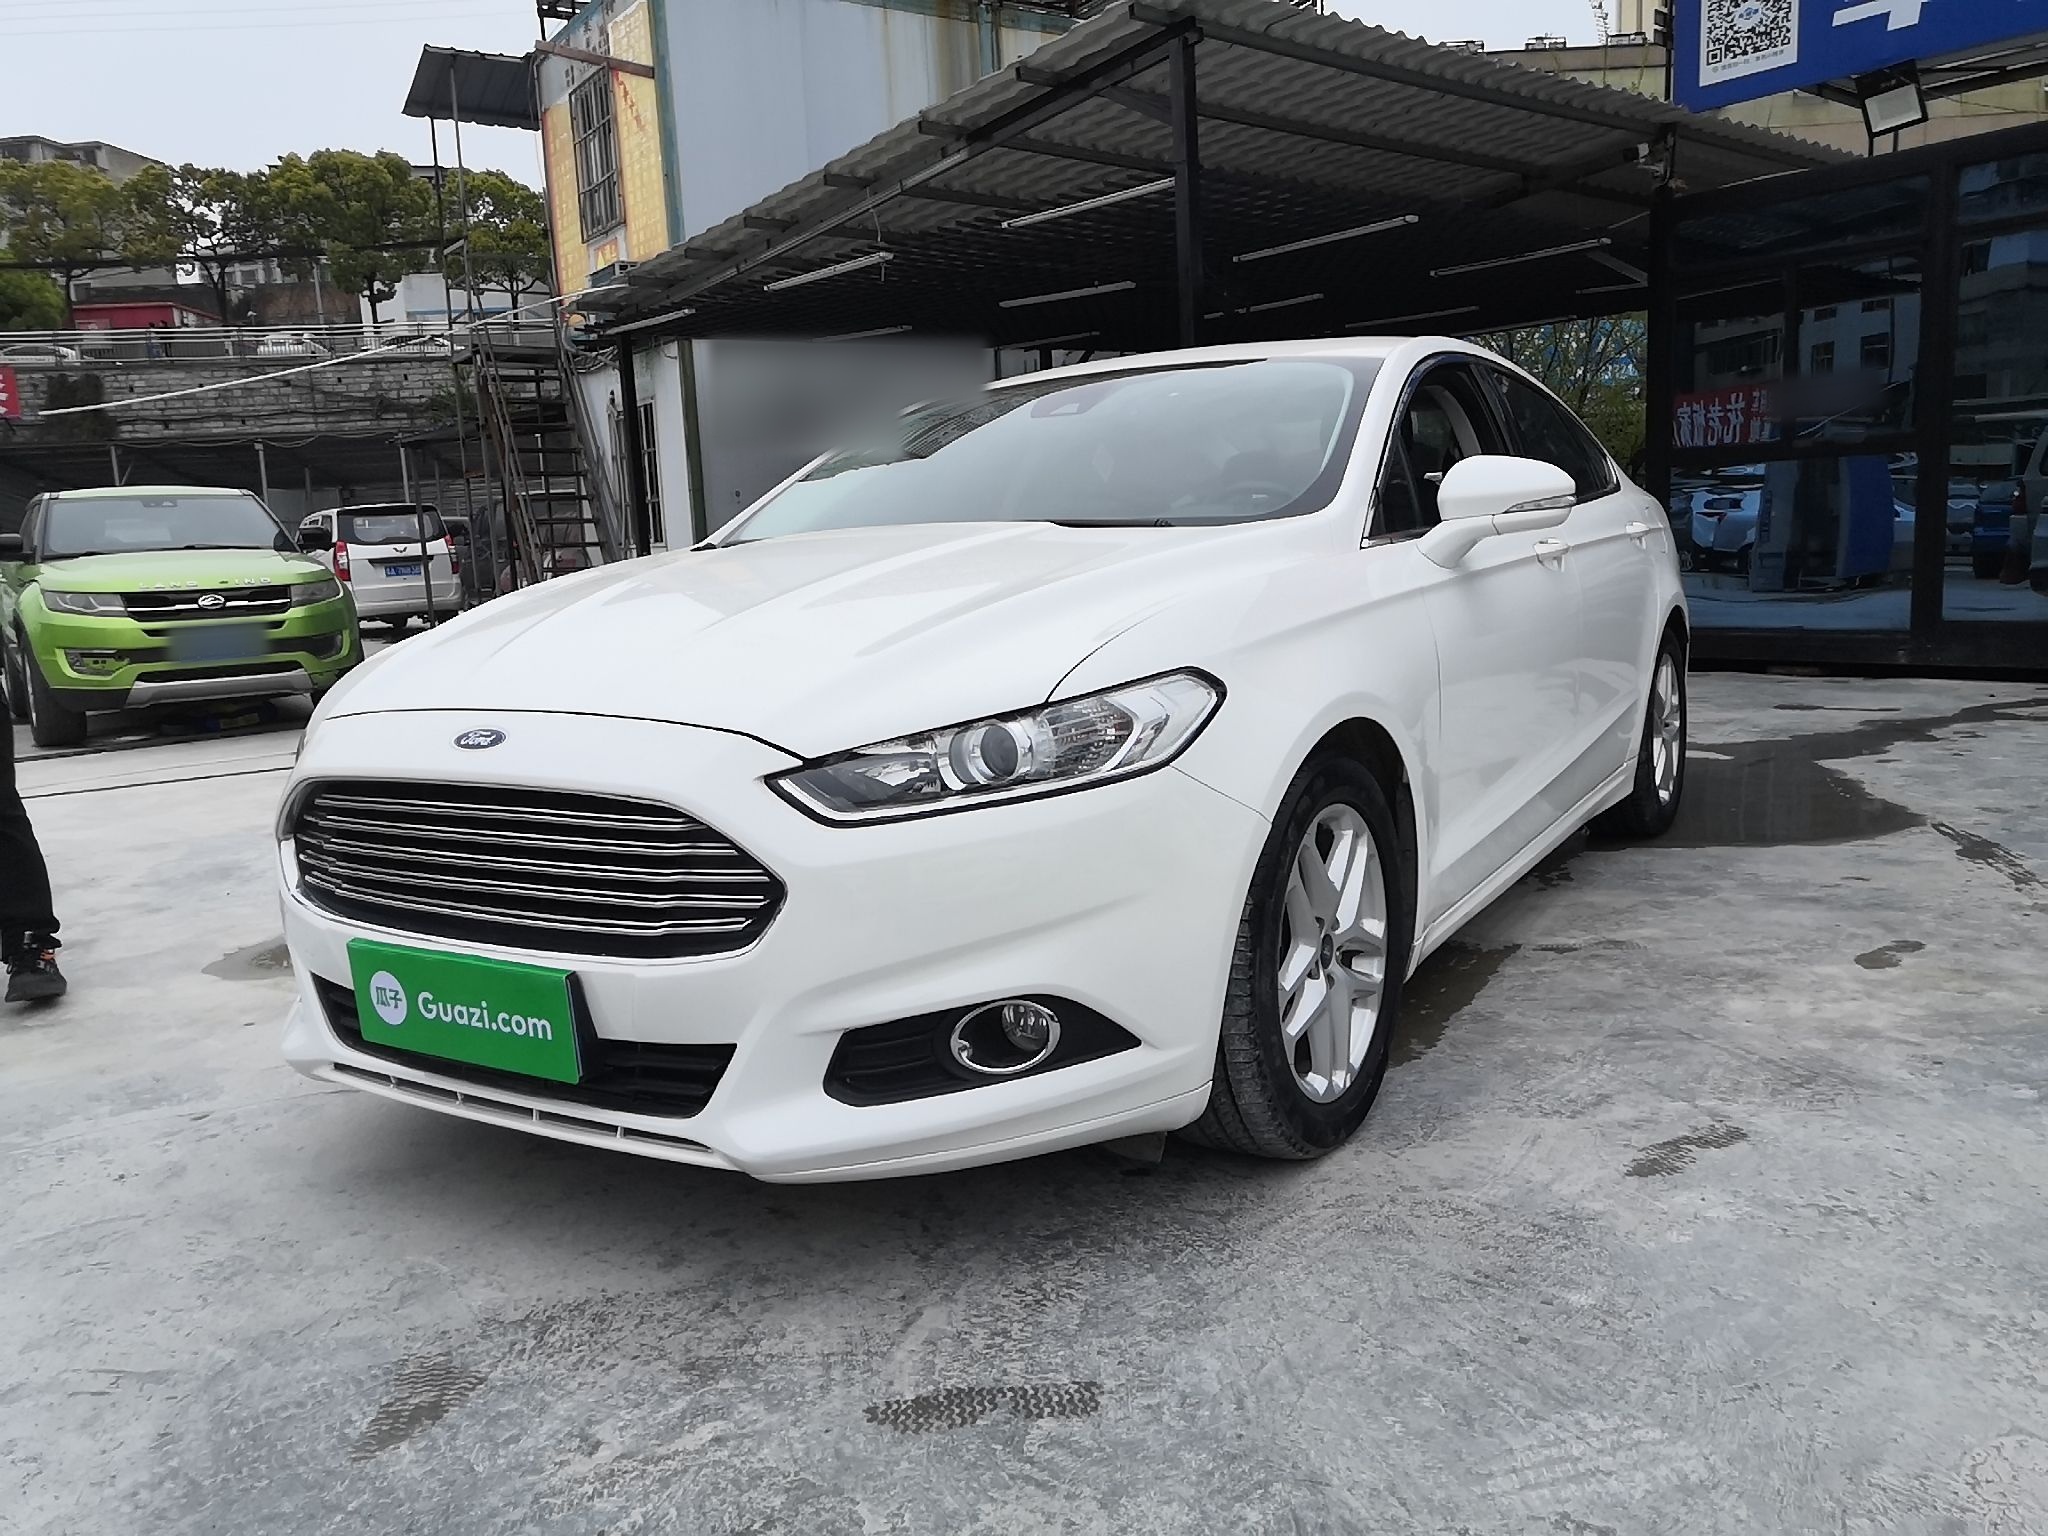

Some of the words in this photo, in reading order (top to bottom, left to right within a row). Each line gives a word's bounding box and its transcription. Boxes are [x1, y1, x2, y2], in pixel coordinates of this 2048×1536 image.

[460, 730, 497, 746] Ford
[375, 986, 403, 1009] 瓜子
[417, 991, 553, 1041] Guazi.com
